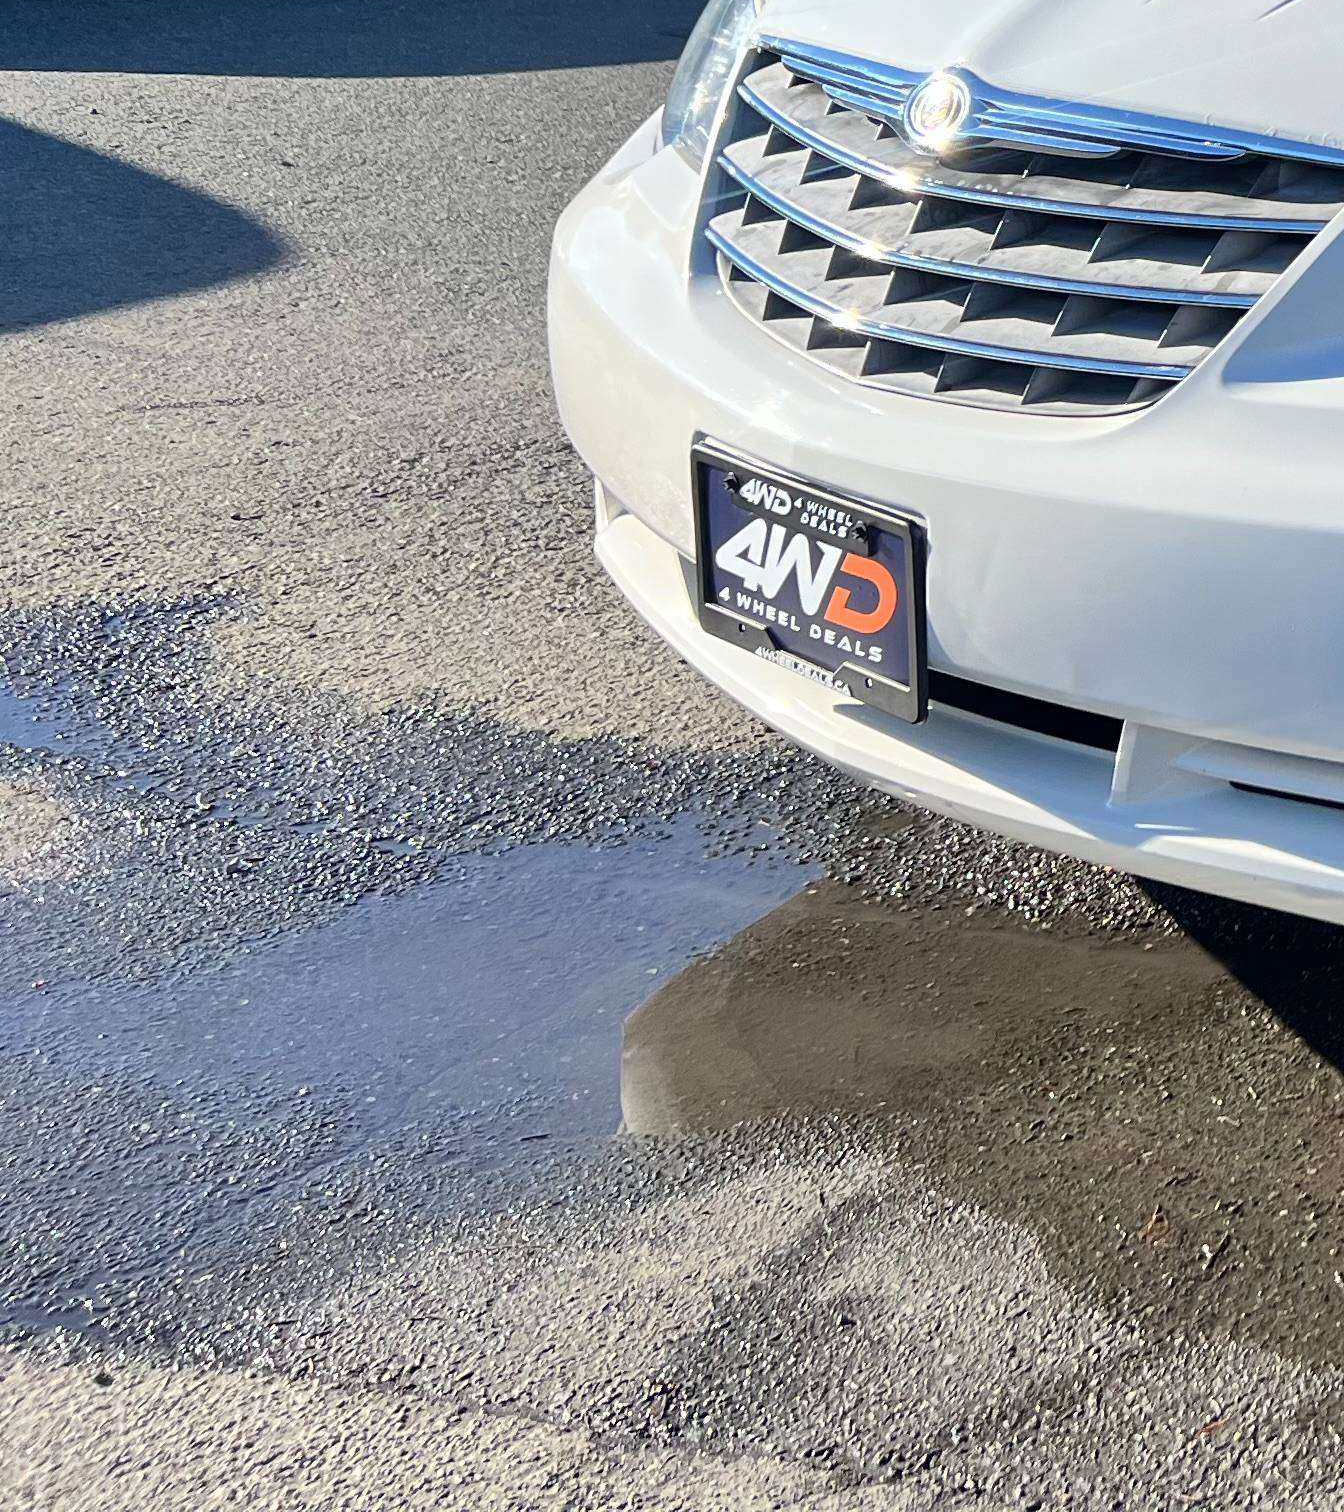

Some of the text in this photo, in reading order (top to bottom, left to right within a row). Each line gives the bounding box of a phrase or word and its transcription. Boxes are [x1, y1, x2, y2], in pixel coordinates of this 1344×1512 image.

[740, 478, 853, 527] 4WD 4 WHEEL
[800, 511, 848, 538] DEALS
[715, 518, 897, 634] 4WD
[719, 587, 883, 663] 4 WHEEL DEALS
